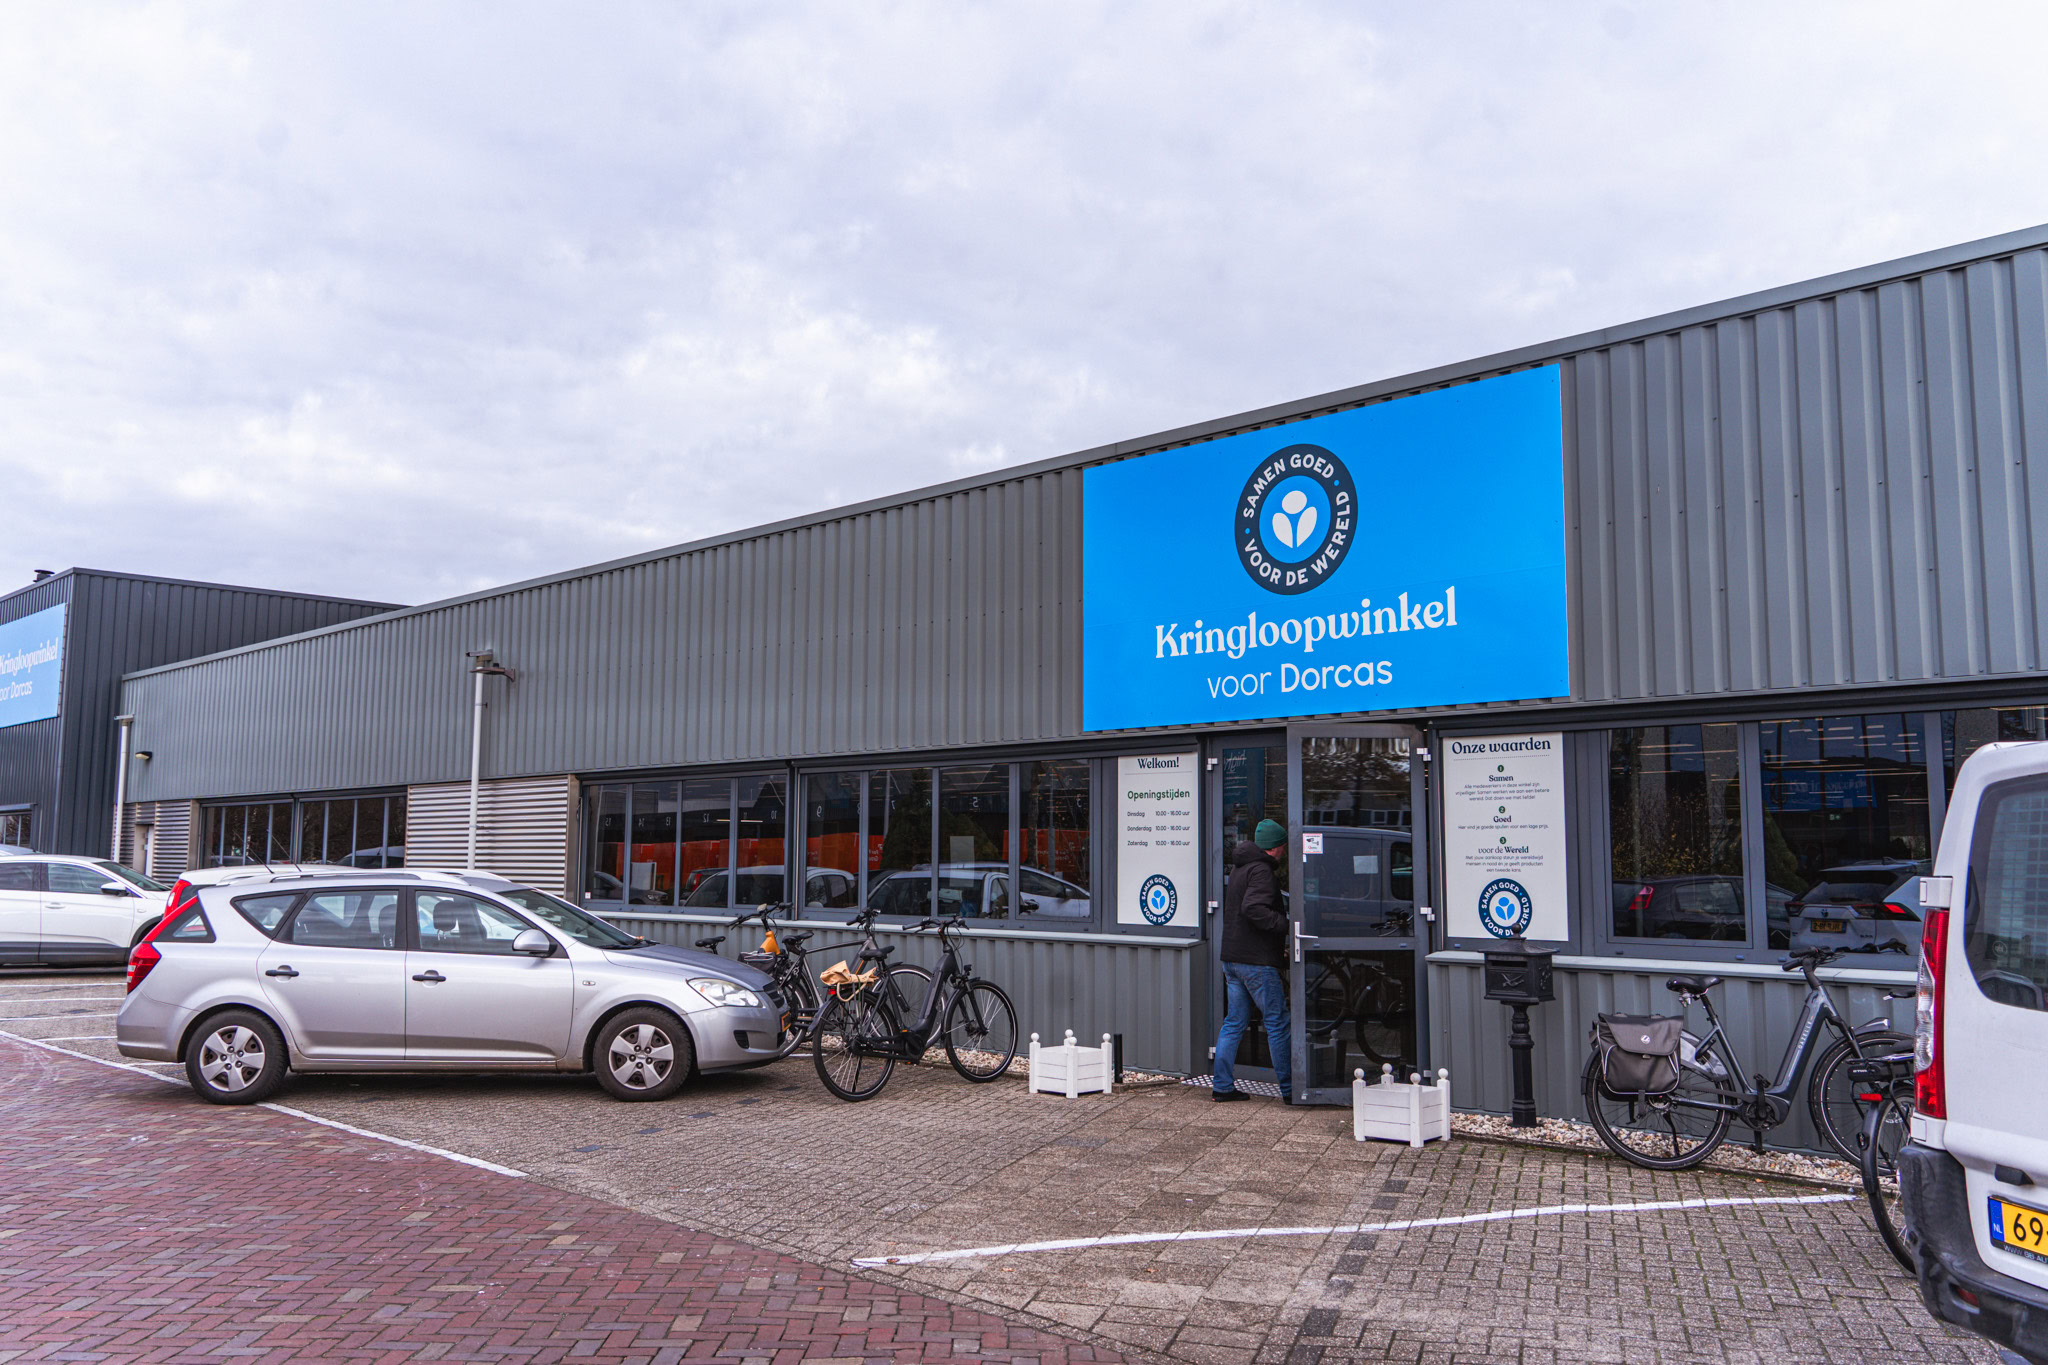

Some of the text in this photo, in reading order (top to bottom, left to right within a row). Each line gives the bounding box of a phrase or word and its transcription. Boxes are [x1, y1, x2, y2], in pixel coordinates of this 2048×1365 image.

[1243, 453, 1335, 519] SAMEN GOED
[1244, 491, 1351, 587] VOOR DE WERELD
[1155, 586, 1458, 659] Kringloopwinkel
[1207, 660, 1393, 699] voor Dorcas
[0, 681, 33, 701] oor Dorcas
[1452, 737, 1551, 755] Onze waarden
[1137, 756, 1180, 769] Welkom!
[1488, 774, 1514, 782] Samen
[1127, 788, 1190, 802] Openingstijden
[1493, 815, 1512, 823] Goed
[1481, 881, 1520, 909] SAMEN GOED
[1485, 917, 1504, 936] VOOR
[1993, 1222, 2003, 1234] NL
